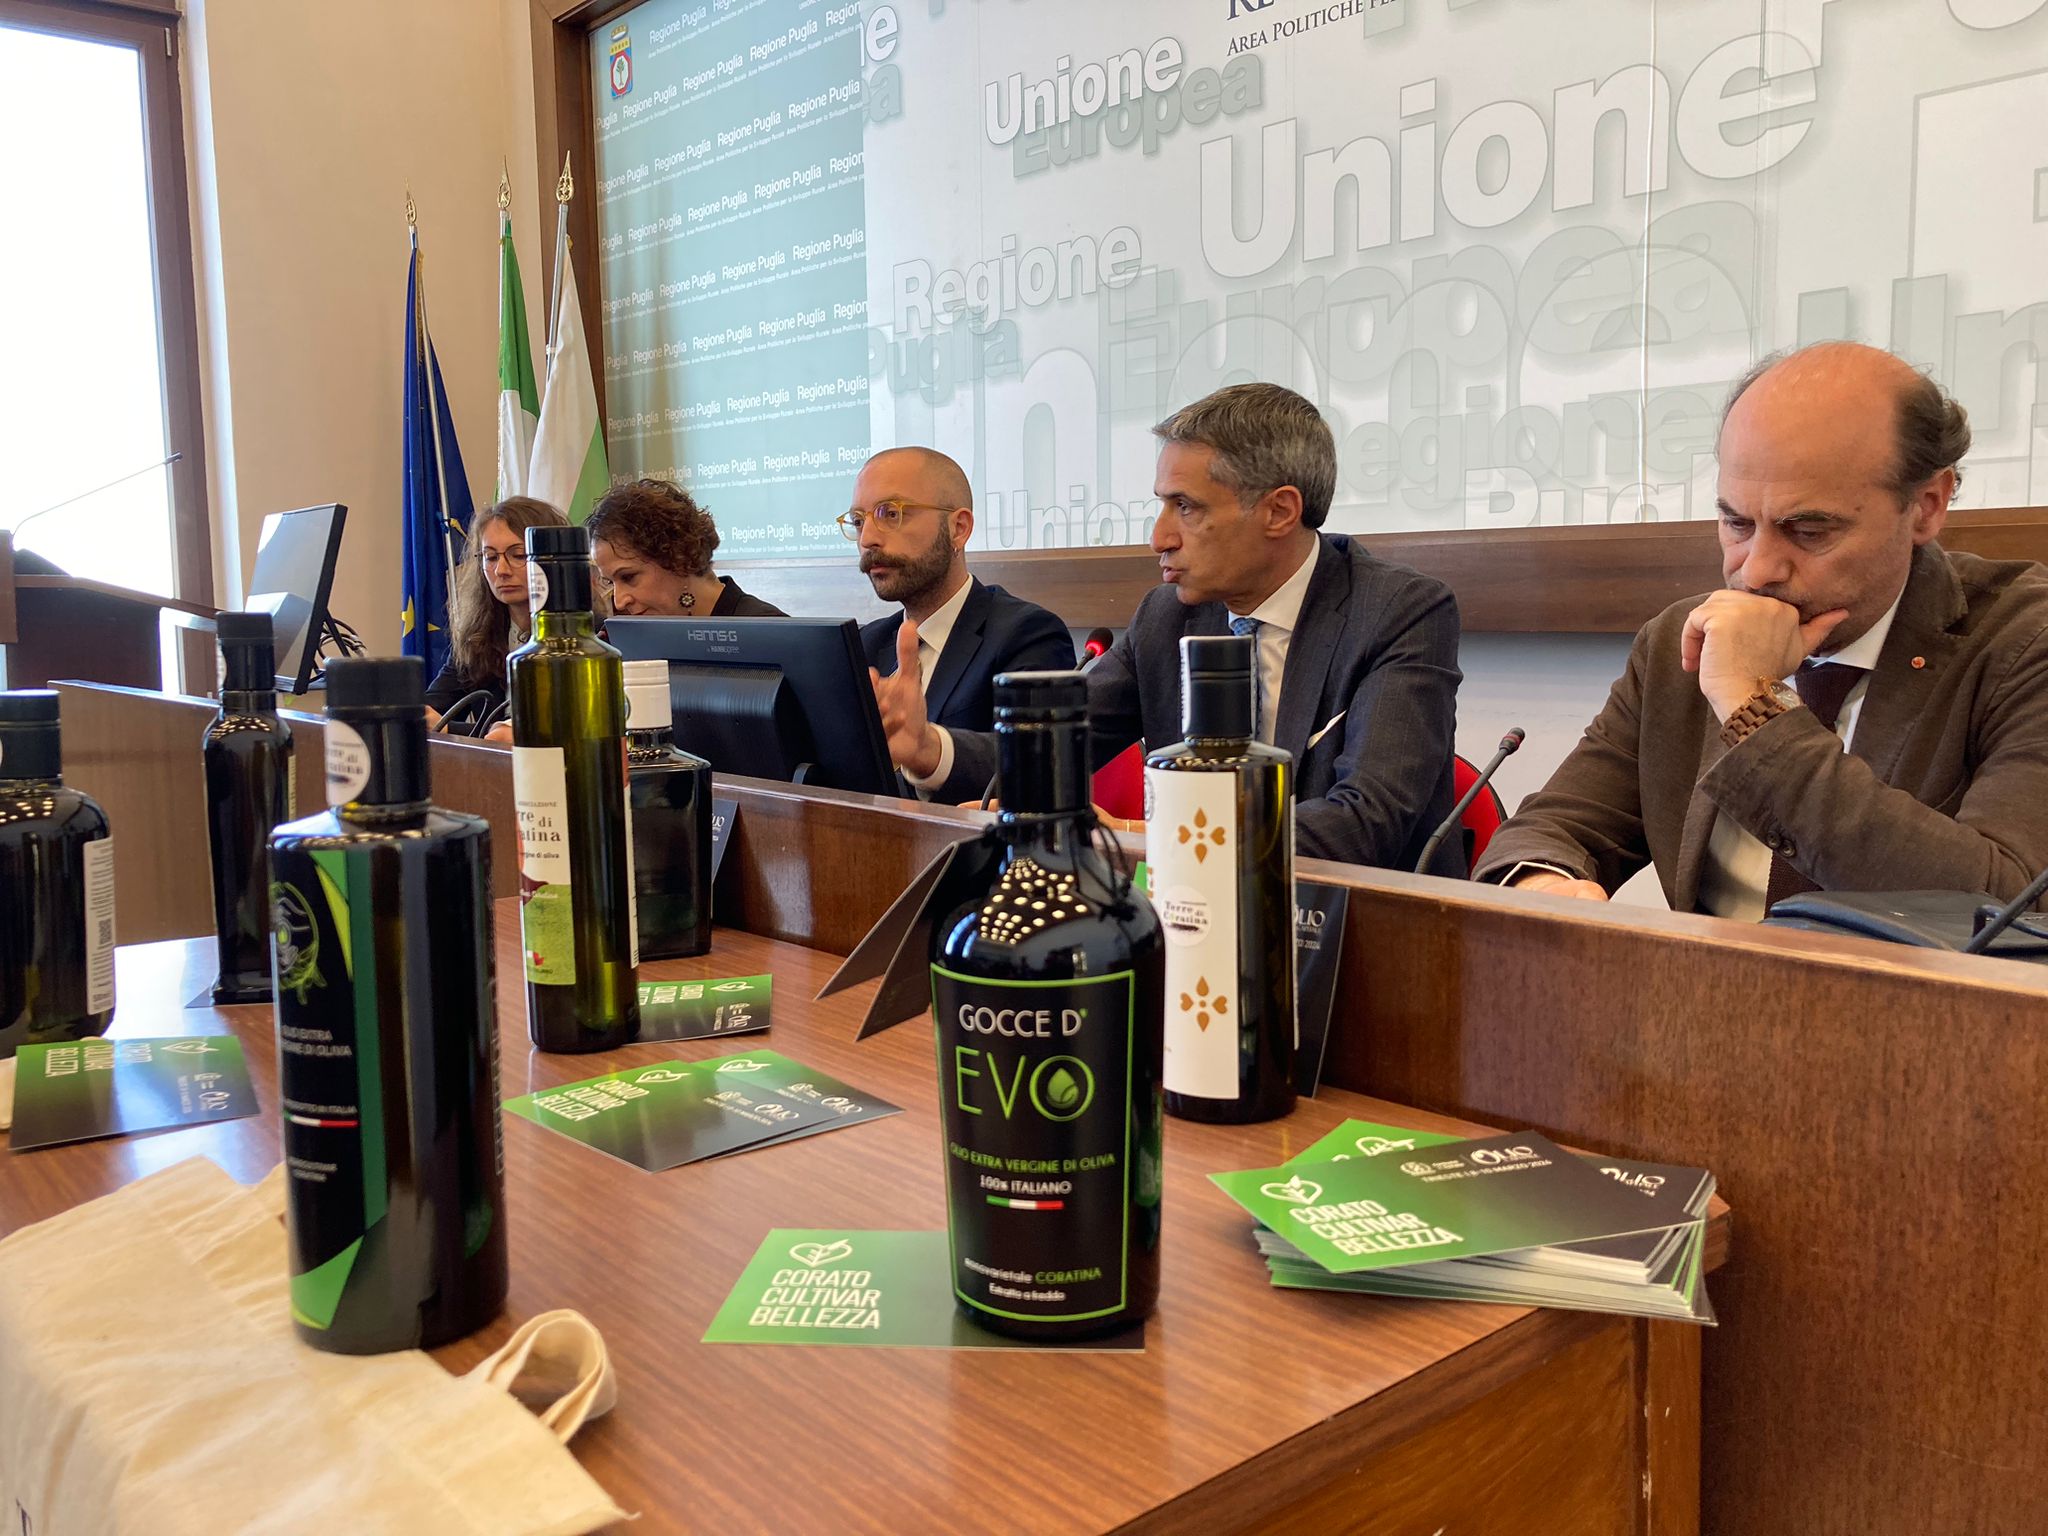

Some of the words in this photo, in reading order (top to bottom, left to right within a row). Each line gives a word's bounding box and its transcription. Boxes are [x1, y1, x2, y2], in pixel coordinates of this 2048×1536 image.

[649, 20, 681, 44] Regione
[682, 6, 707, 28] Puglia
[1227, 30, 1268, 56] AREA
[1273, 1, 1363, 42] POLITICHE
[623, 97, 652, 119] Regione
[653, 85, 677, 105] Puglia
[683, 67, 716, 91] Regione
[717, 54, 743, 77] Puglia
[750, 35, 787, 61] Regione
[788, 19, 818, 44] Puglia
[985, 37, 1184, 145] Unione
[626, 163, 649, 183] Puglia
[654, 151, 685, 173] Regione
[686, 139, 711, 159] Puglia
[717, 124, 752, 148] Regione
[753, 110, 781, 134] Puglia
[788, 93, 827, 119] Regione
[829, 79, 860, 104] Puglia
[1013, 53, 1263, 177] Europea
[1200, 31, 1817, 278] Unione
[628, 222, 657, 242] Regione
[658, 212, 682, 232] Puglia
[687, 201, 720, 222] Regione
[721, 190, 748, 211] Puglia
[754, 177, 791, 199] Regione
[792, 164, 821, 186] Puglia
[631, 288, 654, 306] Puglia
[659, 279, 691, 298] Regione
[691, 270, 716, 290] Puglia
[722, 261, 756, 281] Regione
[757, 250, 785, 270] Puglia
[792, 239, 831, 261] Regione
[833, 228, 864, 249] Puglia
[893, 225, 1142, 336] Regione
[633, 346, 662, 364] Regione
[663, 340, 687, 358] Puglia
[692, 333, 725, 351] Regione
[726, 324, 753, 344] Puglia
[759, 316, 795, 337] Regione
[797, 307, 826, 328] Puglia
[664, 405, 695, 423] Regione
[696, 400, 721, 418] Puglia
[727, 394, 761, 413] Regione
[762, 387, 790, 408] Puglia
[797, 382, 835, 402] Regione
[837, 375, 868, 395] Puglia
[697, 461, 730, 479] Regione
[731, 457, 757, 476] Puglia
[763, 453, 800, 473] Regione
[801, 447, 830, 468] Puglia
[731, 526, 765, 543] Regione
[767, 524, 794, 542] Puglia
[801, 521, 839, 540] Regione
[538, 816, 552, 827] di
[959, 1003, 1050, 1037] GOCCE
[955, 1046, 1095, 1122] EVO
[970, 1150, 1003, 1170] EXTRA
[1005, 1158, 1060, 1174] VERGINE
[1063, 1159, 1077, 1173] DI
[1079, 1153, 1116, 1171] OLIVA
[1011, 1179, 1073, 1195] ITALIANO
[1289, 1199, 1389, 1226] CORATO
[1310, 1212, 1430, 1241] CULTIVAR
[1331, 1227, 1465, 1257] BELLEZZA
[771, 1268, 873, 1289] CORATO
[1035, 1267, 1102, 1285] CORATINA
[760, 1287, 882, 1309] CULTIVAR
[748, 1305, 881, 1330] BELLEZZA
